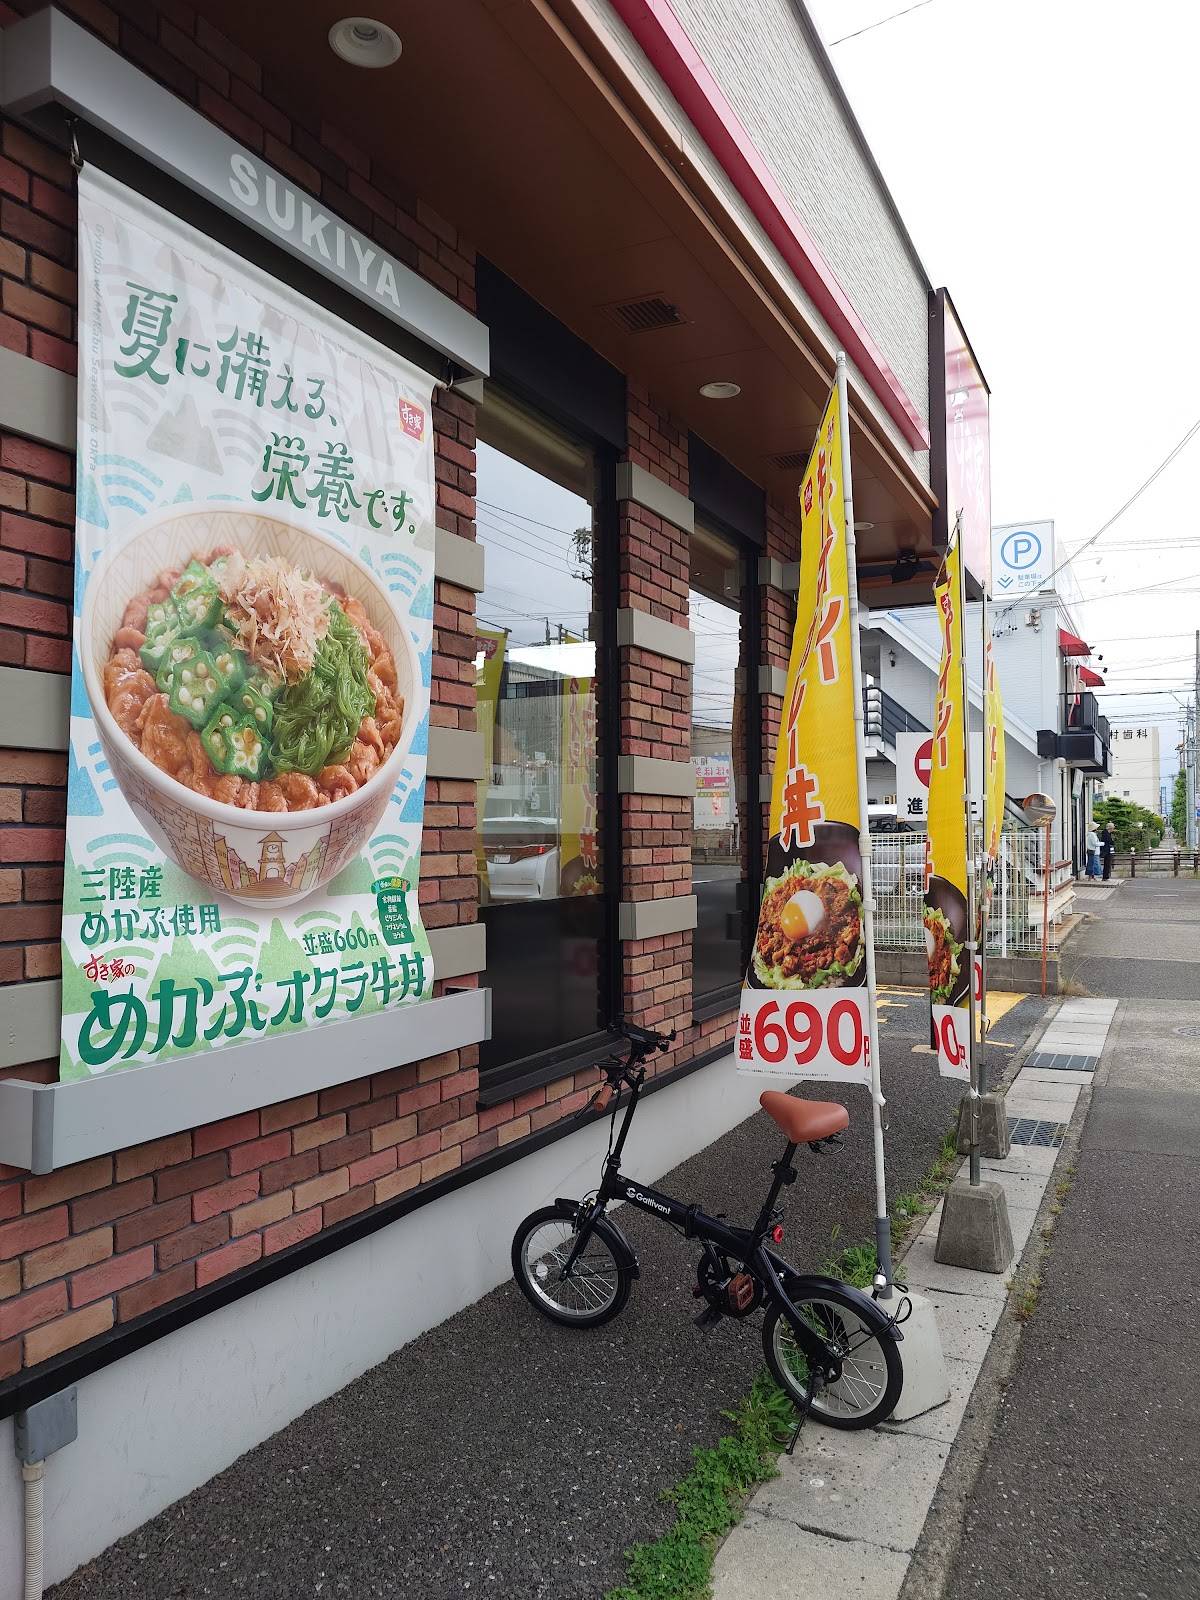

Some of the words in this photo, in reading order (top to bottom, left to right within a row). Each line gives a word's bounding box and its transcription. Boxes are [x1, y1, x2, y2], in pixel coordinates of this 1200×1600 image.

[228, 152, 401, 308] SUKIYA
[114, 281, 337, 427] 夏に備える、
[89, 438, 99, 472] Okra
[251, 431, 416, 535] 栄養です。
[1013, 538, 1032, 564] P
[1110, 728, 1148, 740] 村歯科
[79, 864, 164, 902] 三陸産
[79, 903, 222, 946] めかぶ使用
[303, 926, 380, 957] 並盛660円
[82, 953, 136, 984] すき家の
[77, 951, 425, 1067] めかぶオクラ牛丼
[636, 1192, 672, 1215] Gallivant
